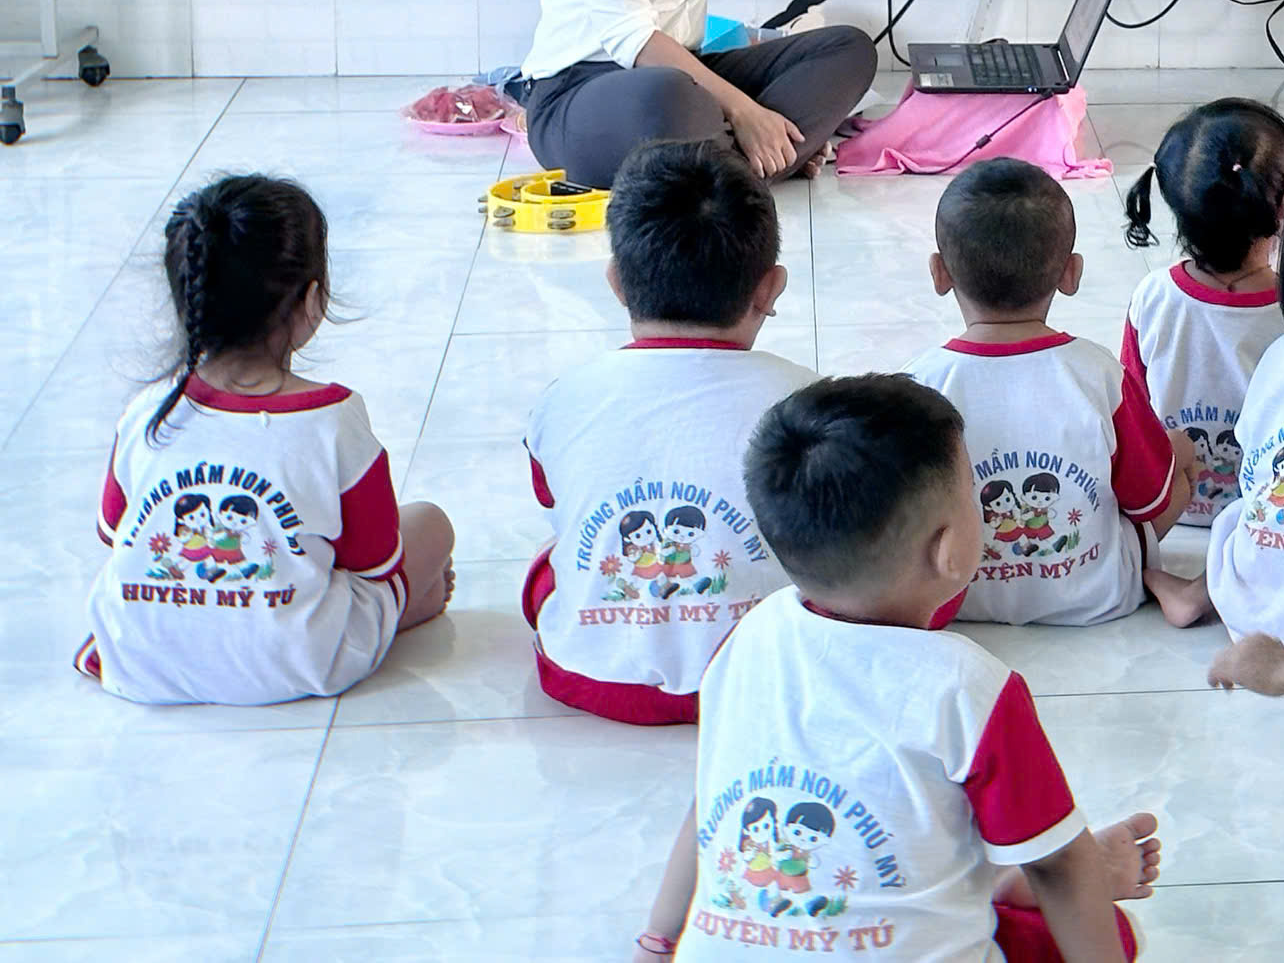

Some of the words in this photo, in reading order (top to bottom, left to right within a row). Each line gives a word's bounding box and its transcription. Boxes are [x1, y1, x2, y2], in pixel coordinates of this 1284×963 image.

[1026, 451, 1063, 473] NON
[1065, 463, 1100, 492] PHÚ
[228, 465, 273, 498] NON
[265, 489, 304, 531] PHÚ
[577, 501, 616, 573] TRƯỜNG
[616, 477, 664, 511] MẦM
[671, 481, 713, 508] NON
[711, 497, 755, 536] PHÚ
[743, 535, 770, 565] MỸ
[1039, 557, 1076, 579] MỸ
[122, 583, 206, 608] HUYỆN
[216, 586, 254, 608] MỸ
[264, 586, 297, 608] TÚ
[578, 603, 671, 629] HUYỆN
[679, 601, 721, 623] MỸ
[800, 768, 849, 810] NON
[843, 800, 895, 850] PHÚ
[874, 854, 908, 889] MỸ
[787, 926, 840, 952] MỸ
[848, 918, 895, 951] TÚ
